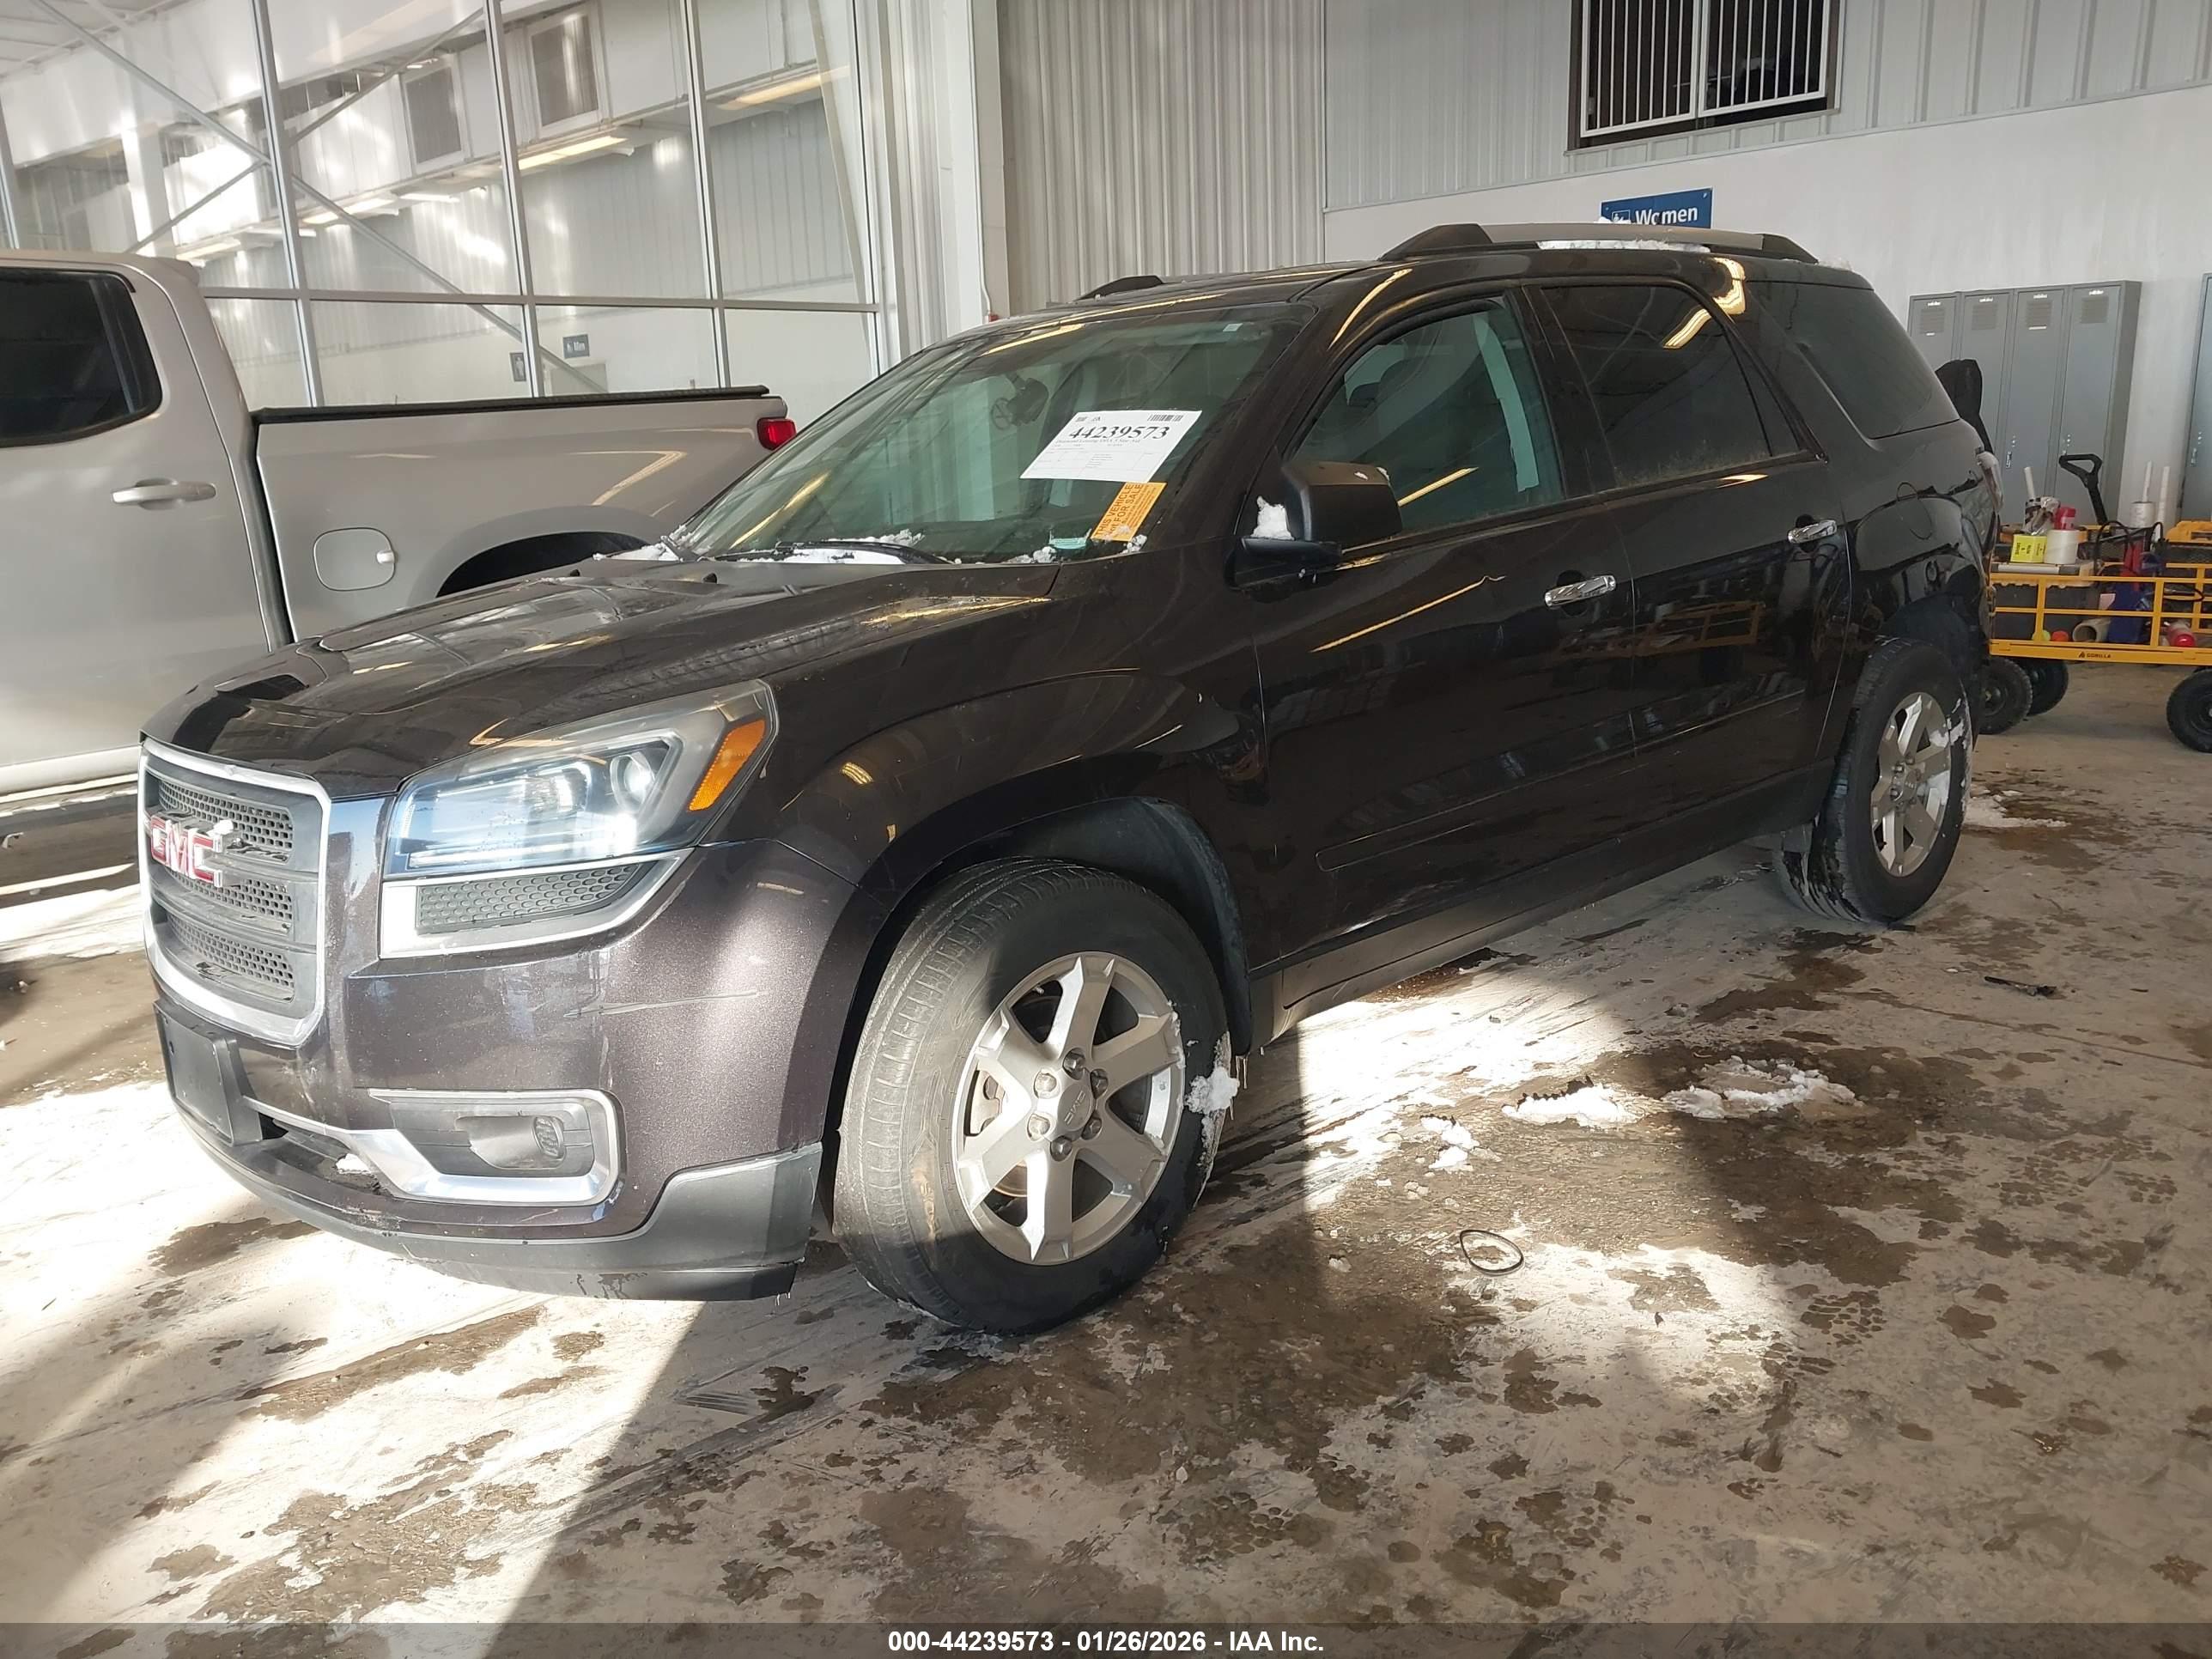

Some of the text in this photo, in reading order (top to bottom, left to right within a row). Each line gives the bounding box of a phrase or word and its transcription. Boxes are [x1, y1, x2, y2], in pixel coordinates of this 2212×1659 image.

[1069, 426, 1170, 440] 44239573
[1095, 484, 1133, 536] THIS VEHICLE
[1115, 506, 1130, 522] FOR
[1126, 483, 1143, 504] SALE
[150, 815, 223, 888] GMC
